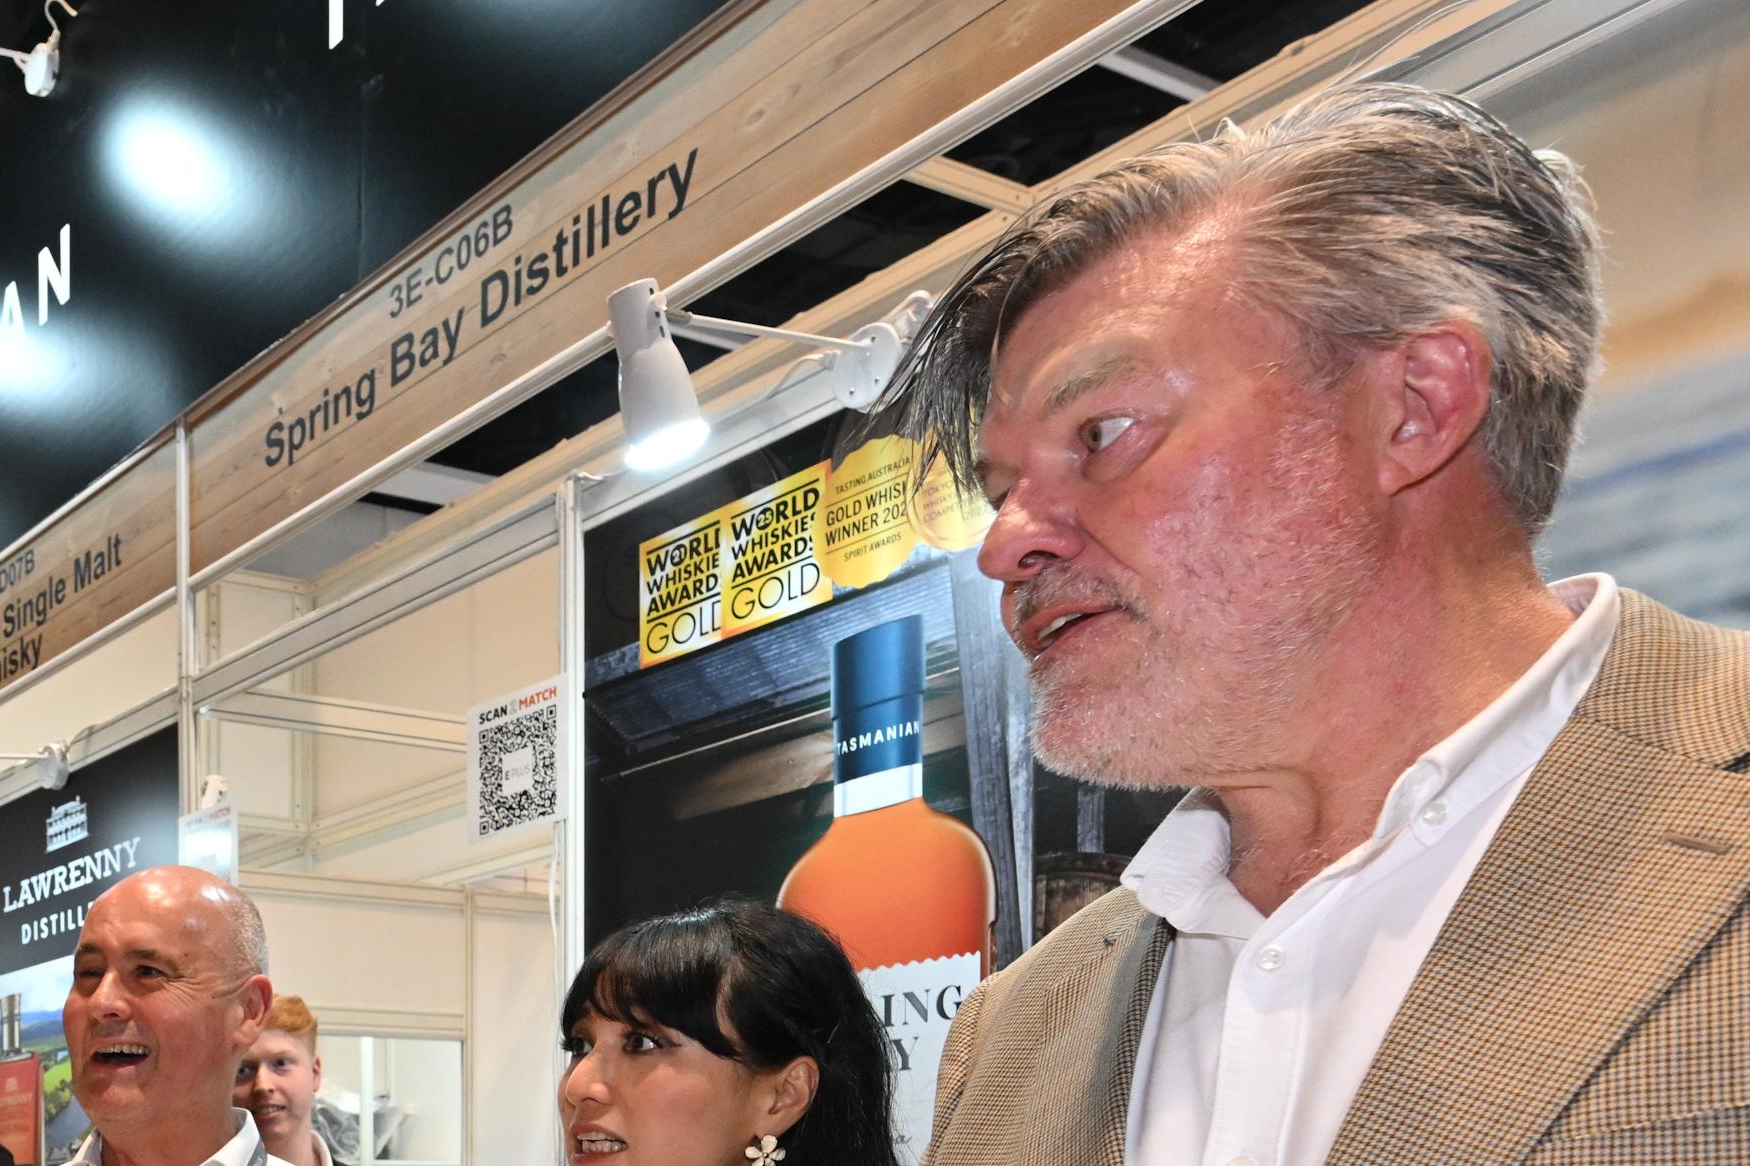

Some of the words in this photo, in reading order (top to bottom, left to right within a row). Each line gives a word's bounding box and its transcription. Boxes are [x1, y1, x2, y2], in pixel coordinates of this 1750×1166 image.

[389, 205, 512, 318] 3E-C06B
[264, 370, 375, 467] Spring
[390, 308, 464, 388] Bay
[480, 148, 698, 328] Distillery
[835, 477, 867, 495] TASTING
[868, 456, 910, 481] AUSTRALIA
[730, 487, 819, 541] WORLD
[825, 513, 879, 547] WINNER
[883, 500, 907, 524] 202
[826, 500, 862, 526] GOLD
[866, 480, 906, 509] WHIS
[843, 545, 866, 561] SPIRIT
[869, 532, 901, 551] AWARDS
[3, 575, 66, 638] Single
[74, 533, 122, 593] Malt
[647, 552, 719, 595] WHISKIE
[647, 573, 721, 616] AWARD
[731, 562, 820, 619] GOLD
[837, 720, 920, 756] TASMANIAN
[3, 836, 141, 913] LAWRENNY
[882, 984, 963, 1027] ING
